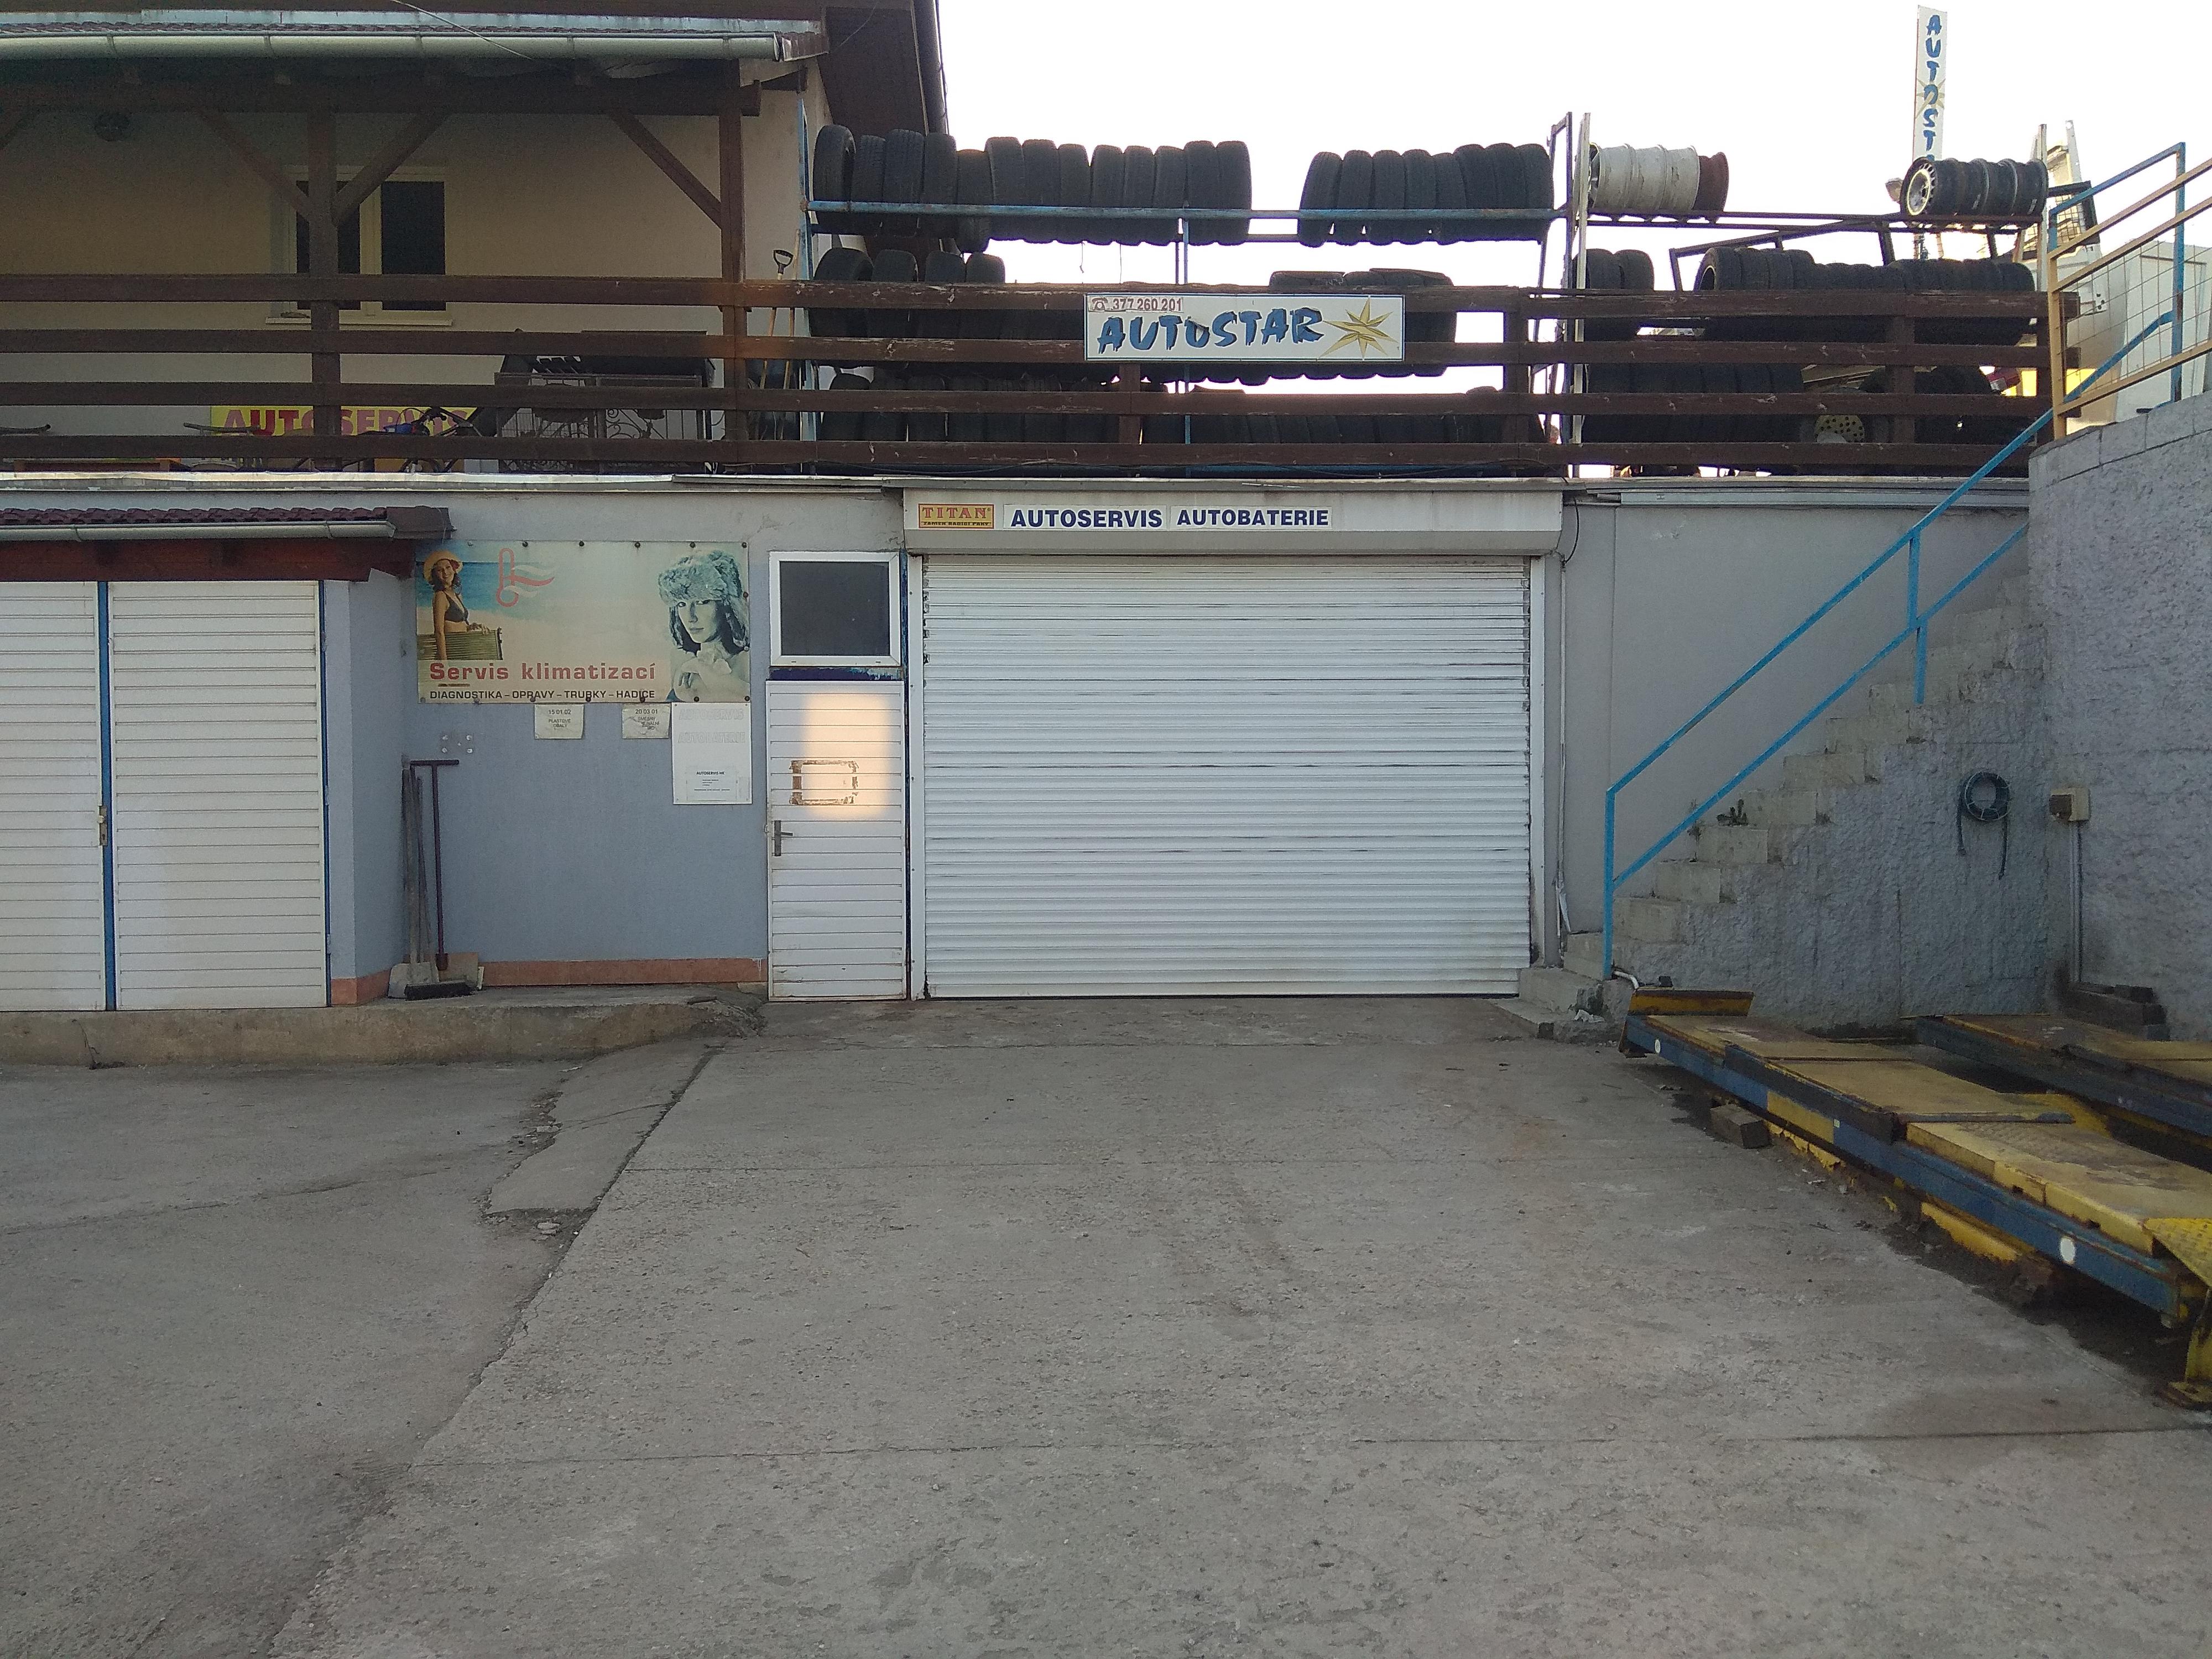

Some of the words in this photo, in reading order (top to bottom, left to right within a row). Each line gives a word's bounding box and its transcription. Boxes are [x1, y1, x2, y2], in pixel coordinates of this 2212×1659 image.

[1112, 298, 1134, 311] 377
[1137, 298, 1158, 311] 260
[1161, 299, 1182, 311] 201
[1097, 307, 1325, 354] AUTOSTAR
[922, 507, 986, 518] TITAN
[1010, 509, 1162, 528] AUTOSERVIS
[1177, 509, 1329, 526] AUTOBATERIE
[429, 662, 509, 680] Servis
[521, 662, 655, 680] klimatizací
[430, 691, 502, 699] DIAGNOSTIKA
[512, 691, 555, 699] OPRAVY
[564, 691, 607, 699] TRUBKY
[617, 691, 655, 699] HADICE
